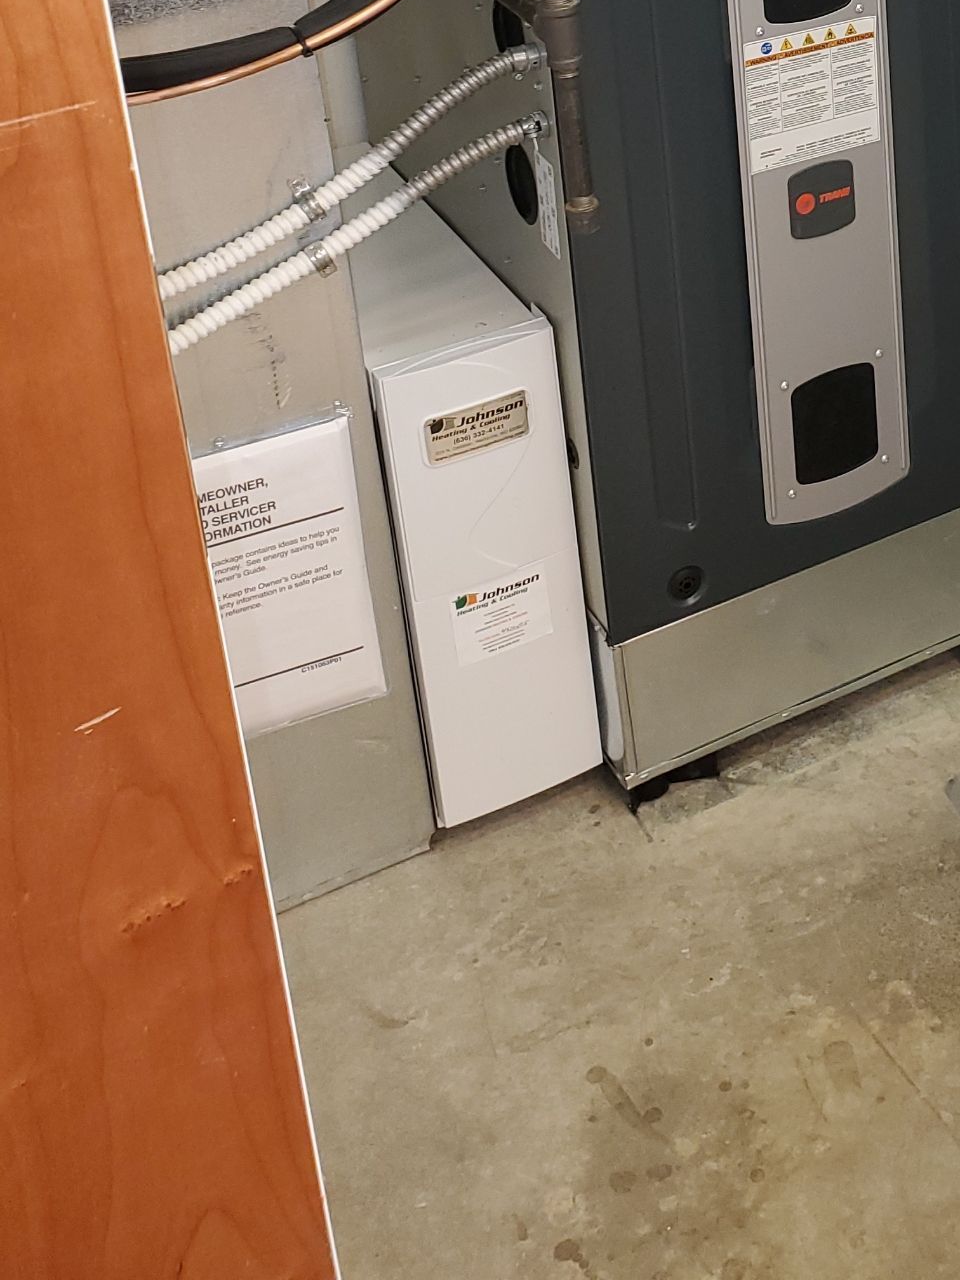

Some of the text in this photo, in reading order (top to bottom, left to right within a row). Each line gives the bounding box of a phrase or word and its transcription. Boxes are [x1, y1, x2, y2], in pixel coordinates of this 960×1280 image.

[432, 427, 468, 442] Heating
[480, 413, 511, 428] Cooling
[456, 399, 524, 427] Johnson
[200, 495, 249, 517] TALLER
[211, 501, 277, 527] SERVICER
[211, 554, 244, 570] package
[245, 544, 277, 558] contains
[278, 539, 299, 549] ideas
[309, 530, 325, 540] help
[326, 526, 340, 536] you
[246, 558, 261, 567] See
[263, 550, 289, 563] energy
[290, 542, 315, 554] saving
[223, 564, 328, 600] Keep the Owner's Guide and
[236, 588, 278, 605] information
[294, 579, 310, 588] safe
[311, 573, 332, 585] place
[333, 568, 343, 576] for
[479, 574, 540, 603] Johnson
[457, 602, 489, 617] Heating
[499, 587, 529, 601] Cooling
